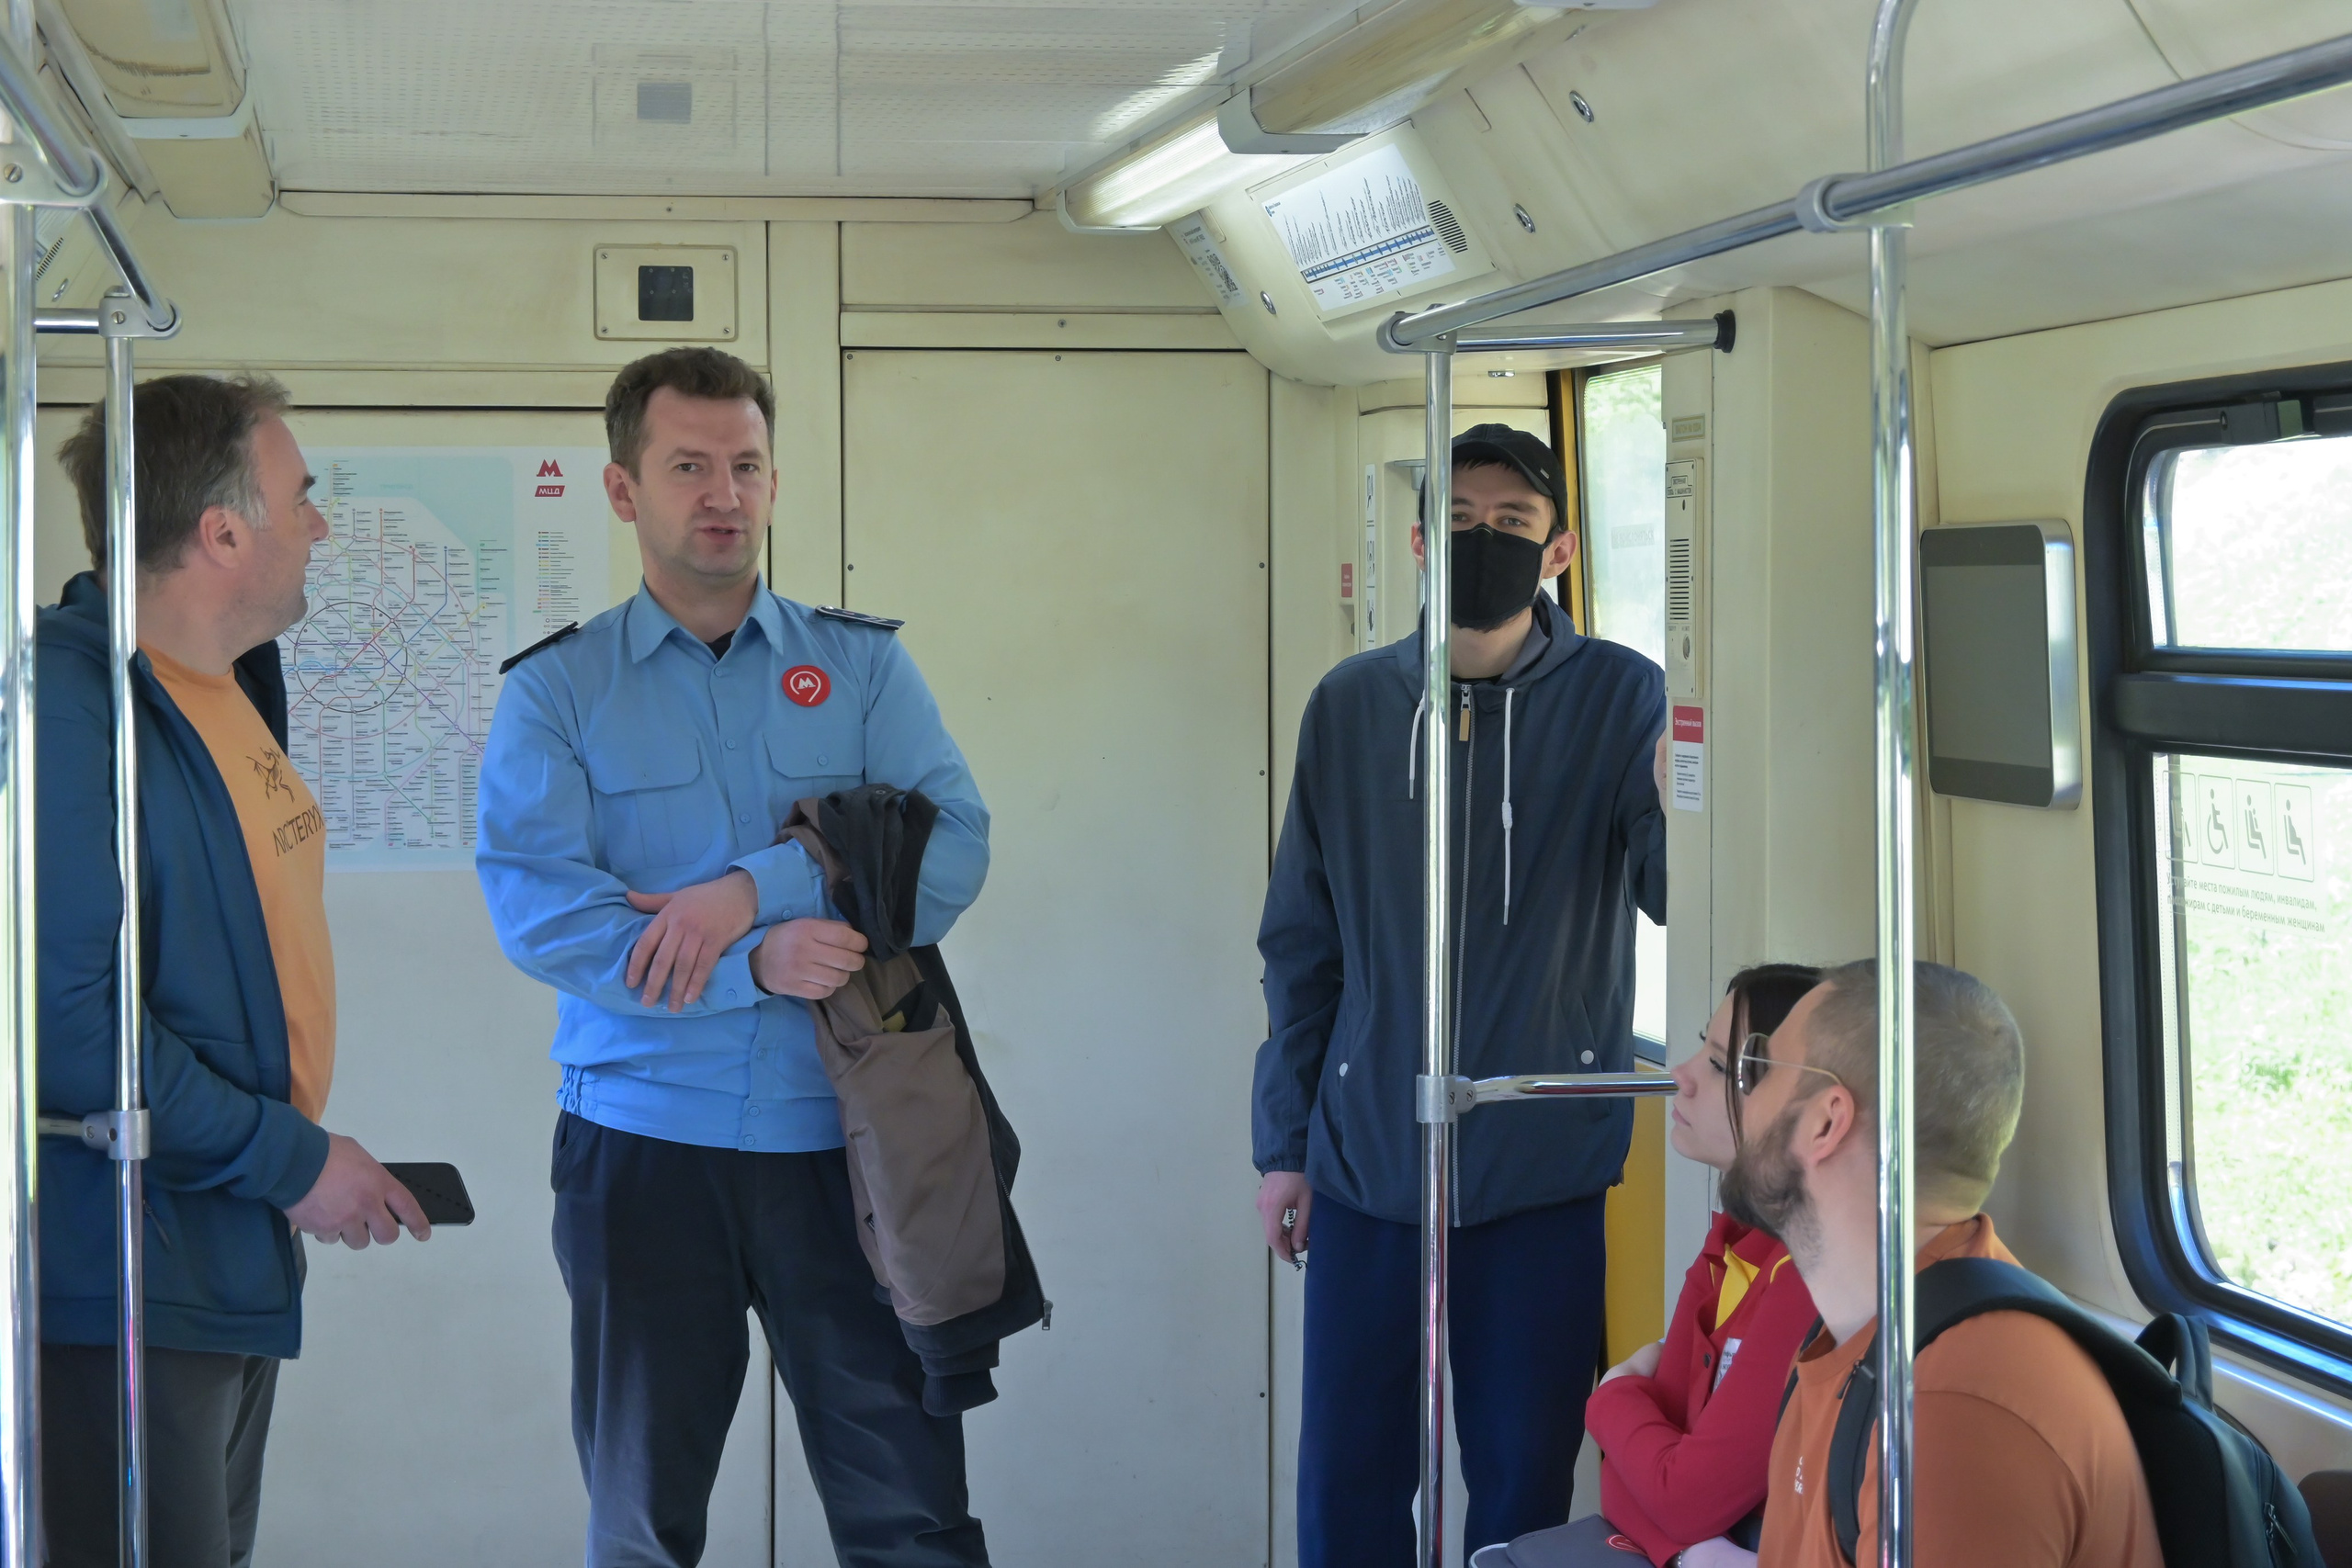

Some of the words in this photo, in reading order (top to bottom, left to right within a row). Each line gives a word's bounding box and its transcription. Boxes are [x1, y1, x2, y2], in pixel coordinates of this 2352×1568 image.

[2166, 872, 2198, 889] Утуайте
[2199, 881, 2217, 893] места
[2218, 884, 2249, 897] пожилым
[2277, 894, 2317, 912] инвалидам,
[2211, 902, 2235, 916] детьми
[2241, 905, 2286, 925] беременным
[2287, 917, 2325, 933] женщинам
